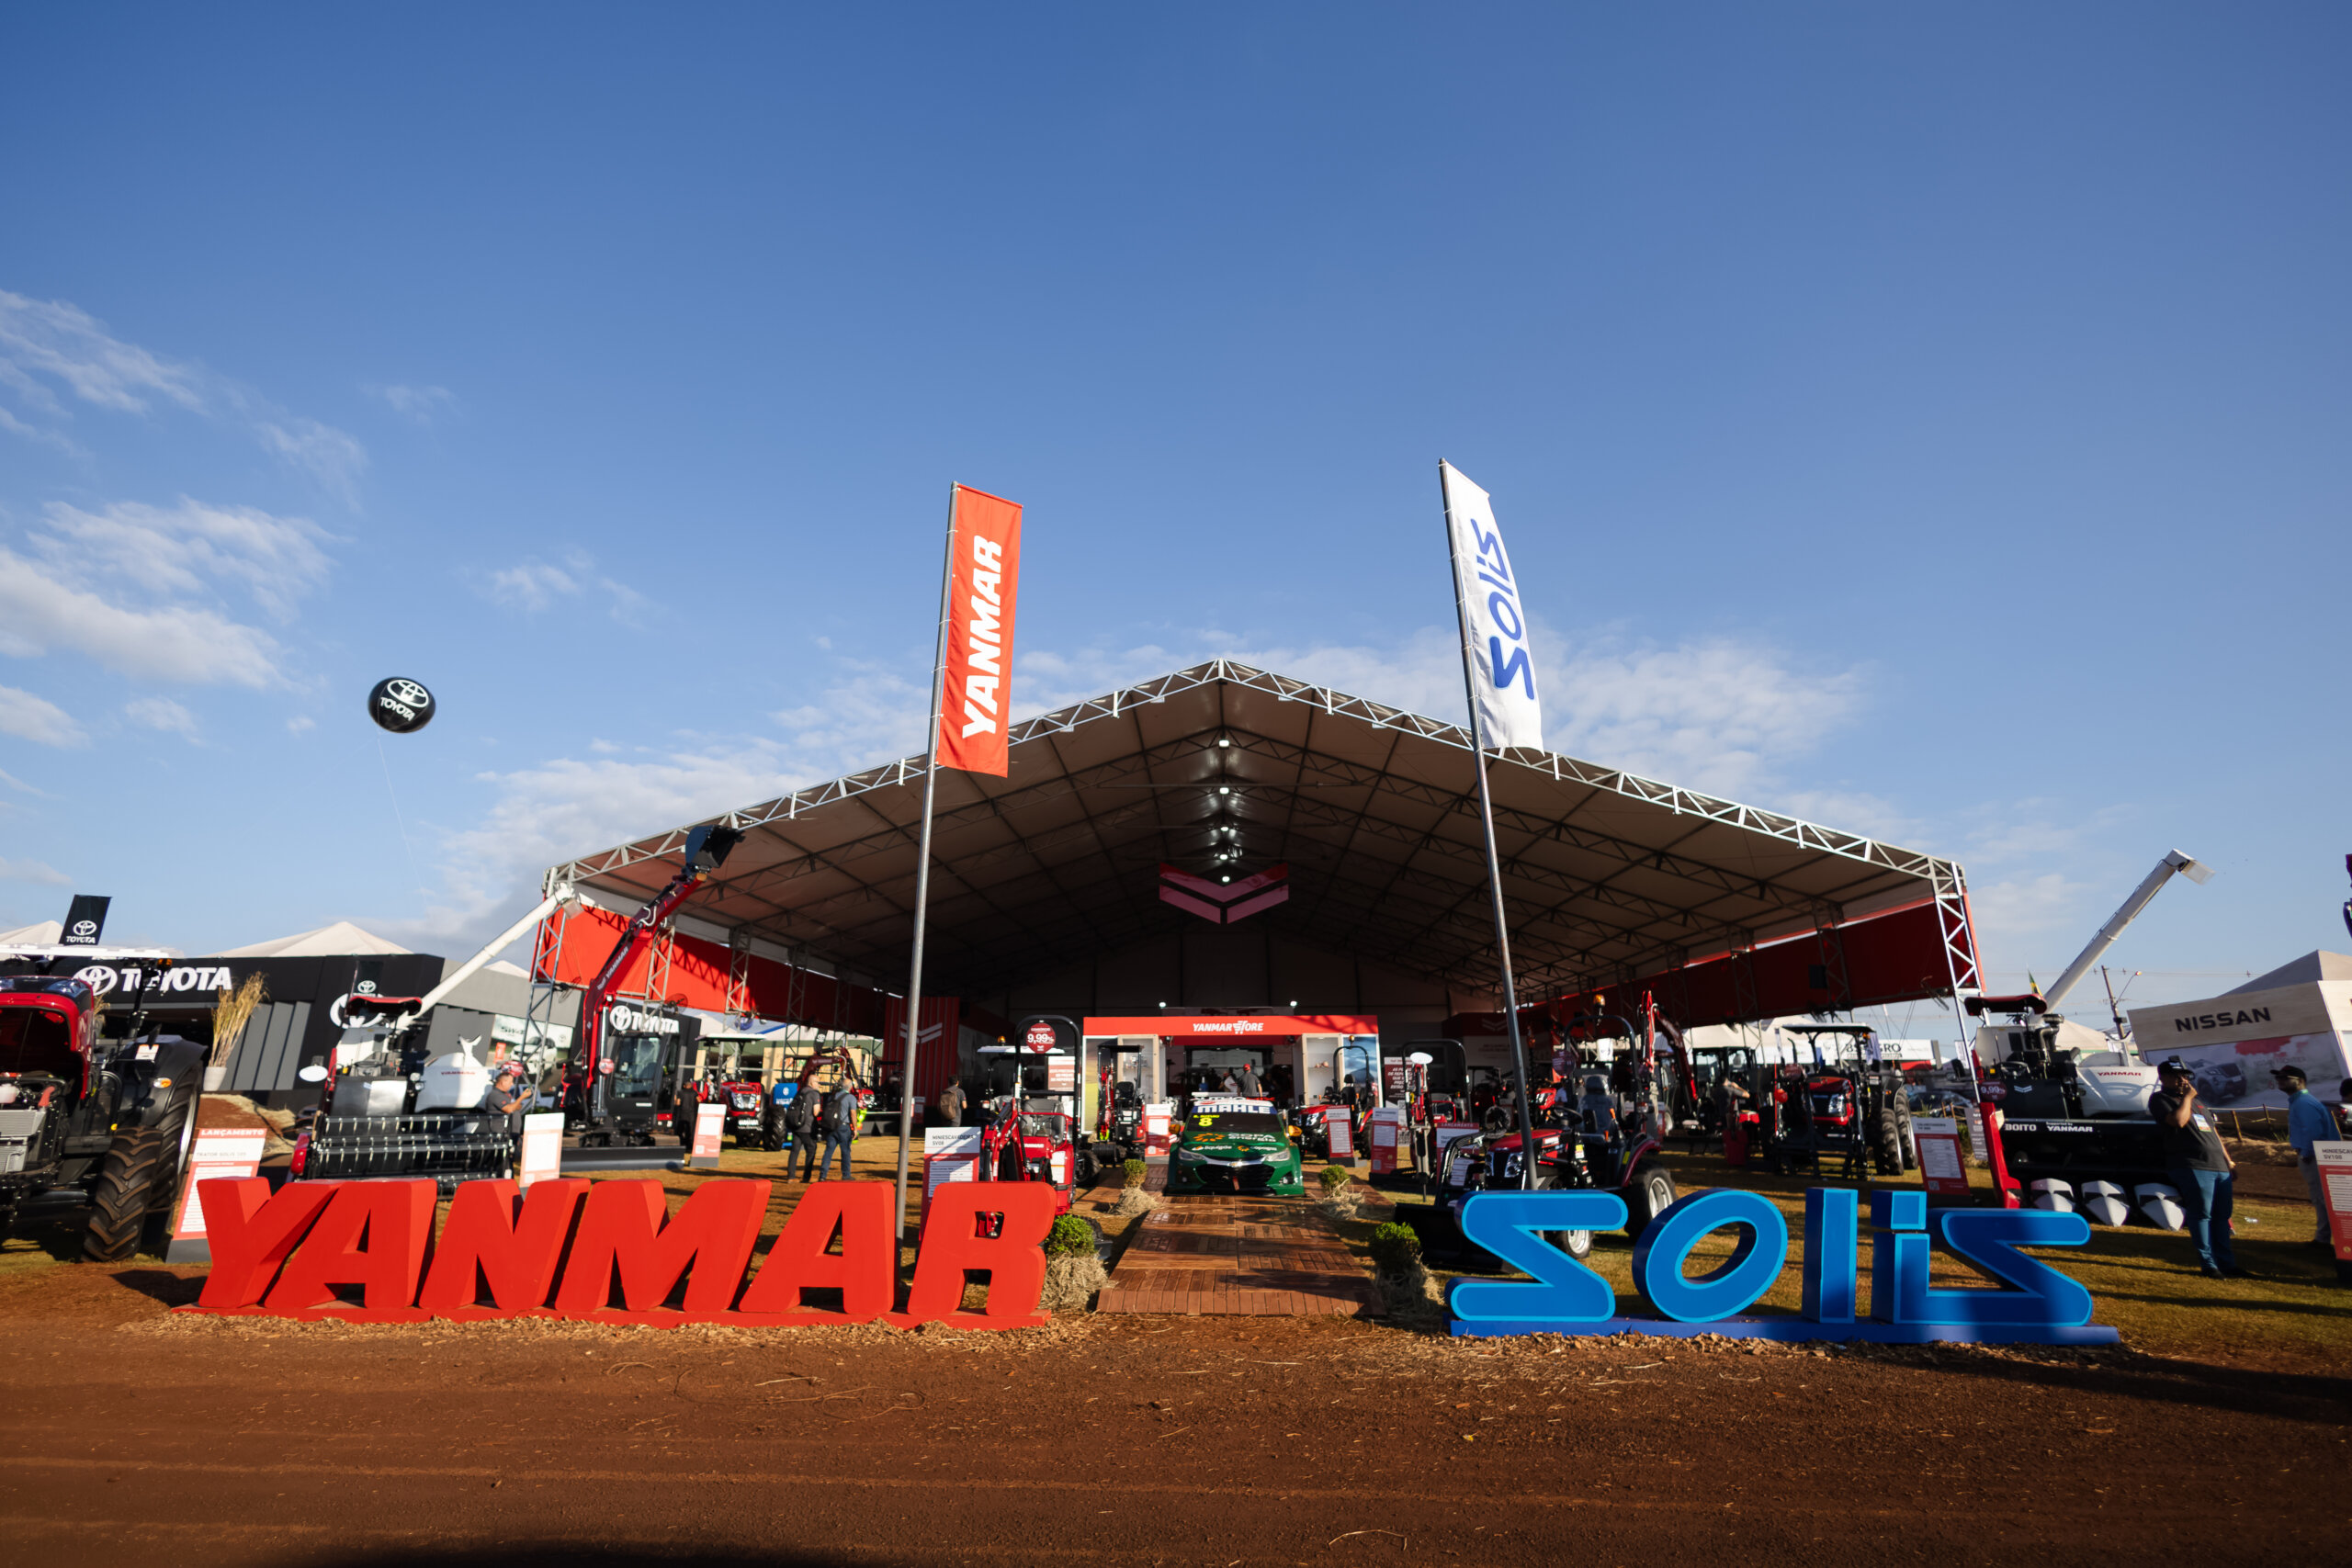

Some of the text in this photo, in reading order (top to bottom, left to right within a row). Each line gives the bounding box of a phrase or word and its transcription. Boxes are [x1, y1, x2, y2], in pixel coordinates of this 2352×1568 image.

[962, 535, 1002, 739] YANMAR
[380, 697, 416, 722] TOYOTA
[66, 935, 96, 944] TOYOTA
[2175, 1007, 2272, 1032] NISSAN
[1193, 1022, 1233, 1032] YANMAR
[1197, 1104, 1271, 1114] MAHLE
[1198, 1117, 1213, 1127] 8
[2005, 1123, 2037, 1132] BOITO
[201, 1129, 265, 1137] LANÇAMENTO
[198, 1177, 1057, 1317] YANMAR
